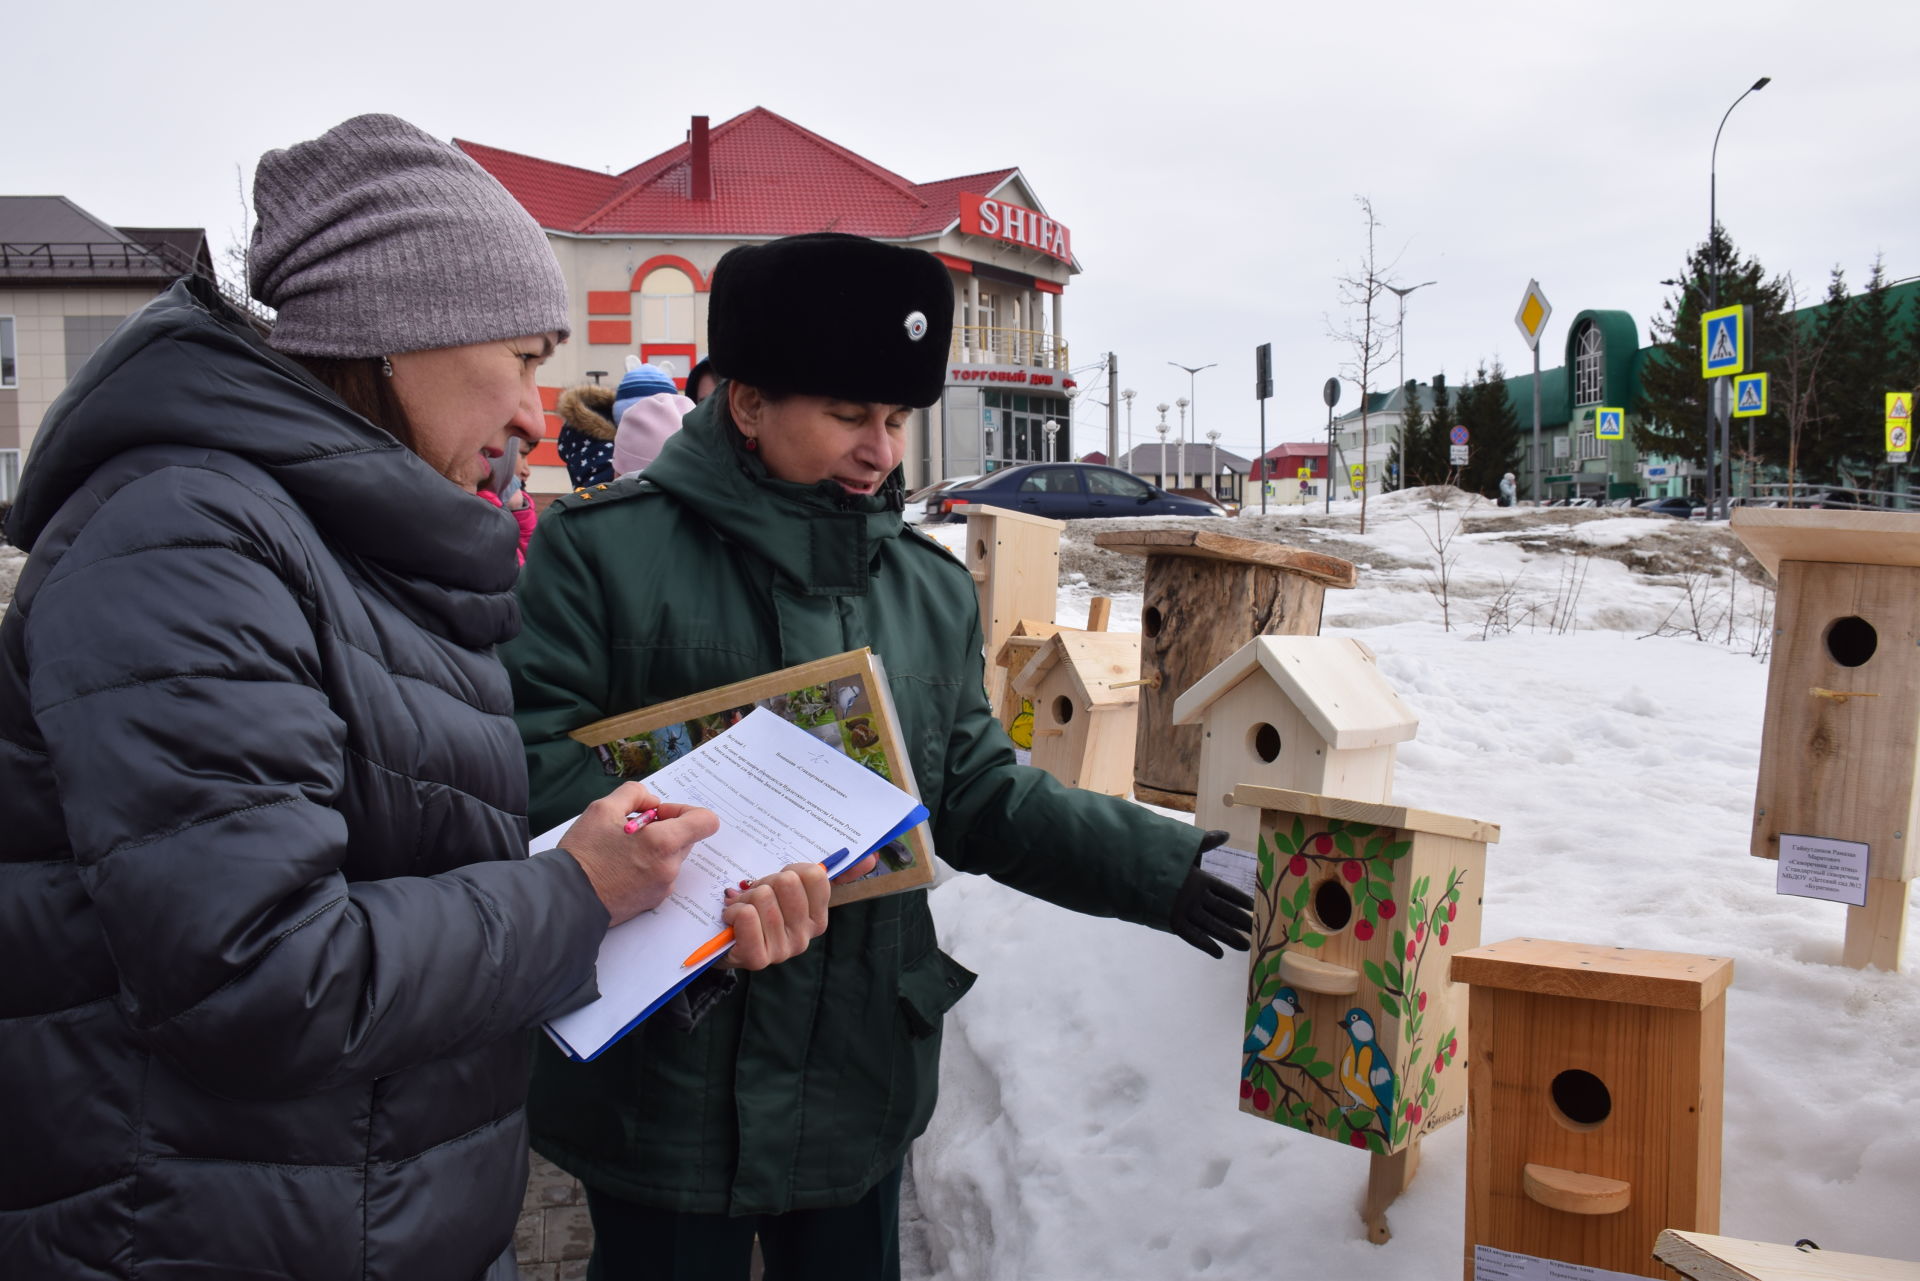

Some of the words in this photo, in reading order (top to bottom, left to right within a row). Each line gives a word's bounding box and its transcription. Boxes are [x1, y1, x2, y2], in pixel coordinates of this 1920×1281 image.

[980, 200, 1067, 258] SHIFA
[952, 369, 1027, 383] ТОРГОВЫЙ
[1785, 866, 1826, 877] Стандартный
